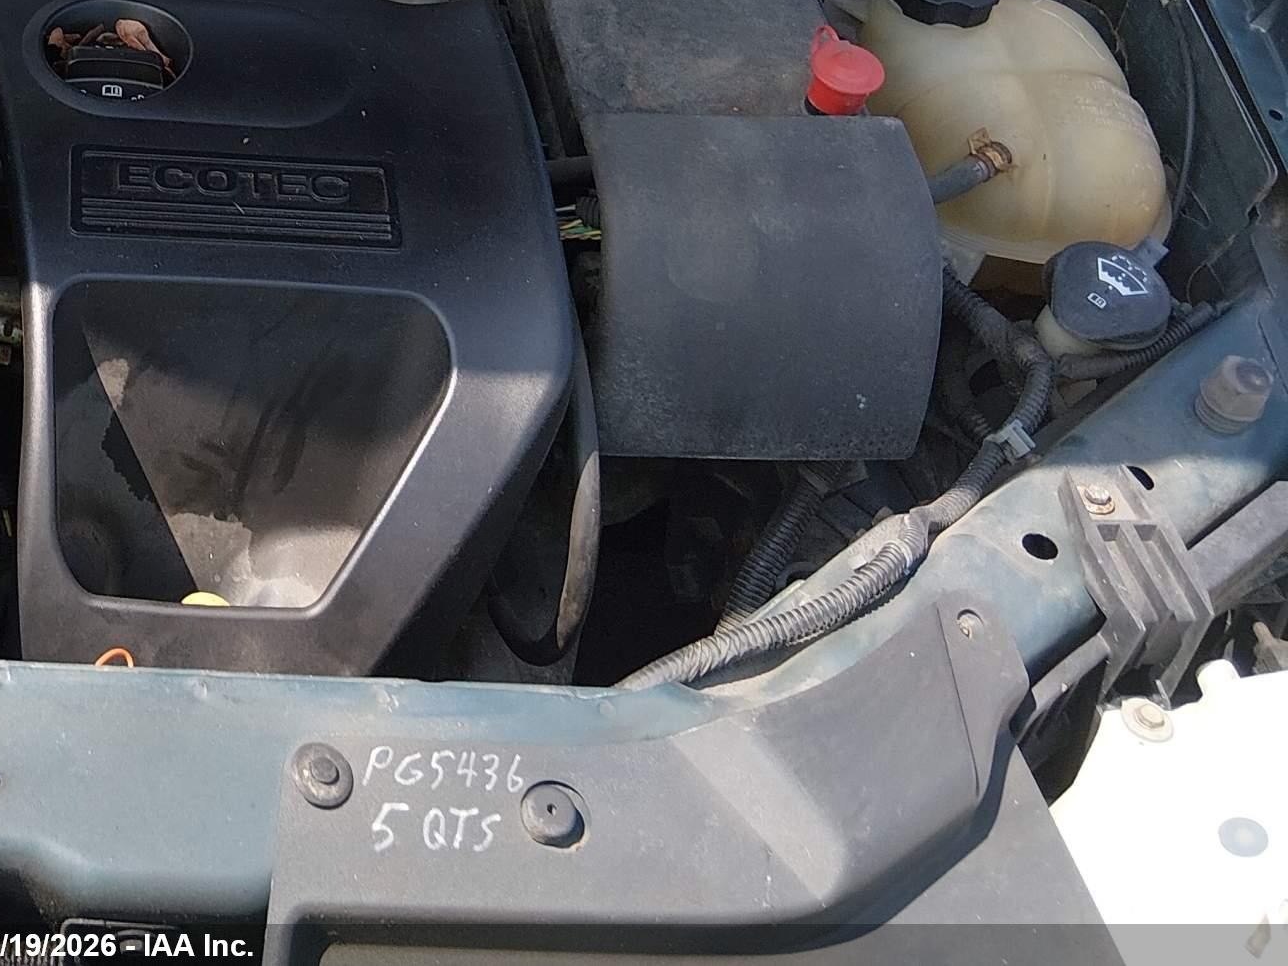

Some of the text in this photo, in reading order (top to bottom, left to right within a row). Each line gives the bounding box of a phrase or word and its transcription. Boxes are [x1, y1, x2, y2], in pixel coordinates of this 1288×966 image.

[115, 163, 351, 205] ECOTEC
[362, 744, 525, 793] PG5436
[371, 802, 502, 852] 5 QTS
